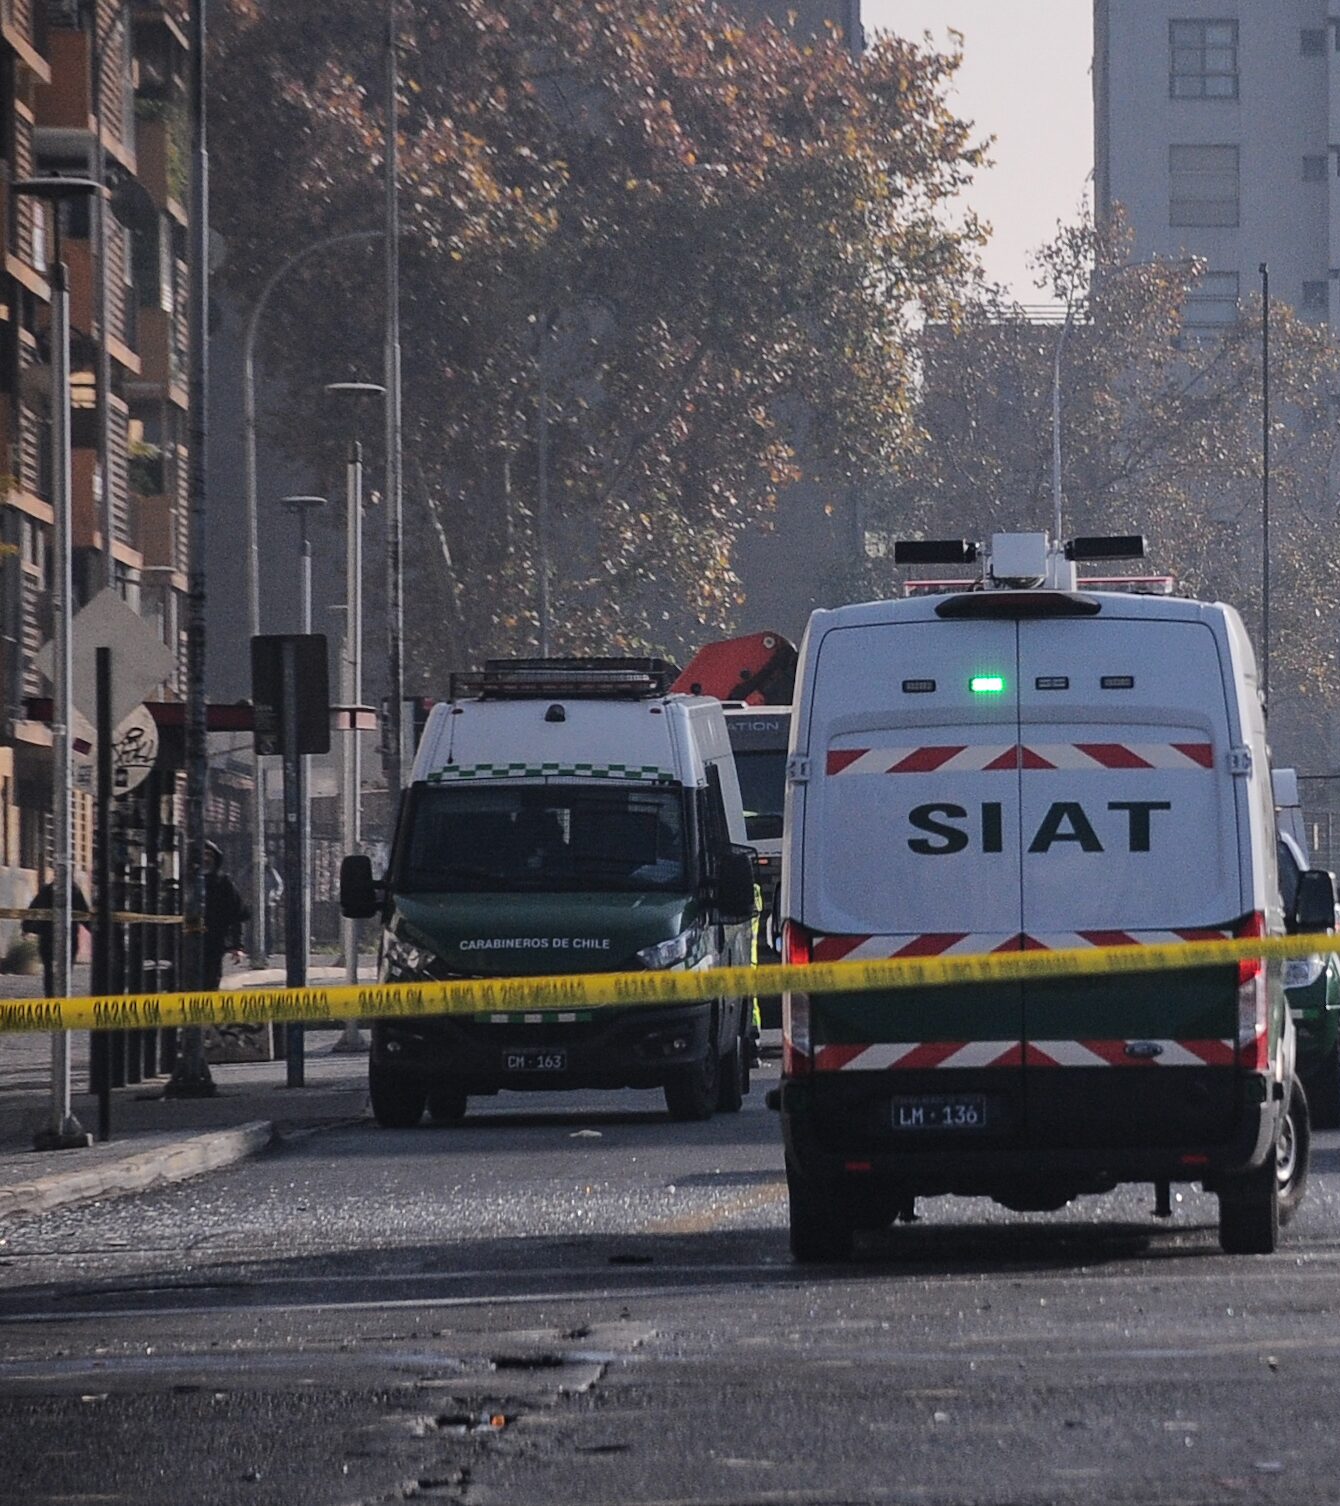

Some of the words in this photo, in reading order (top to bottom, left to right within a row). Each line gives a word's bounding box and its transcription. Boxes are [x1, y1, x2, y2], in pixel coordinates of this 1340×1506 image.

[907, 802, 1171, 855] SIAT
[459, 938, 549, 951] CARABINEROS
[552, 938, 569, 948] DE
[572, 938, 610, 949] CHILE
